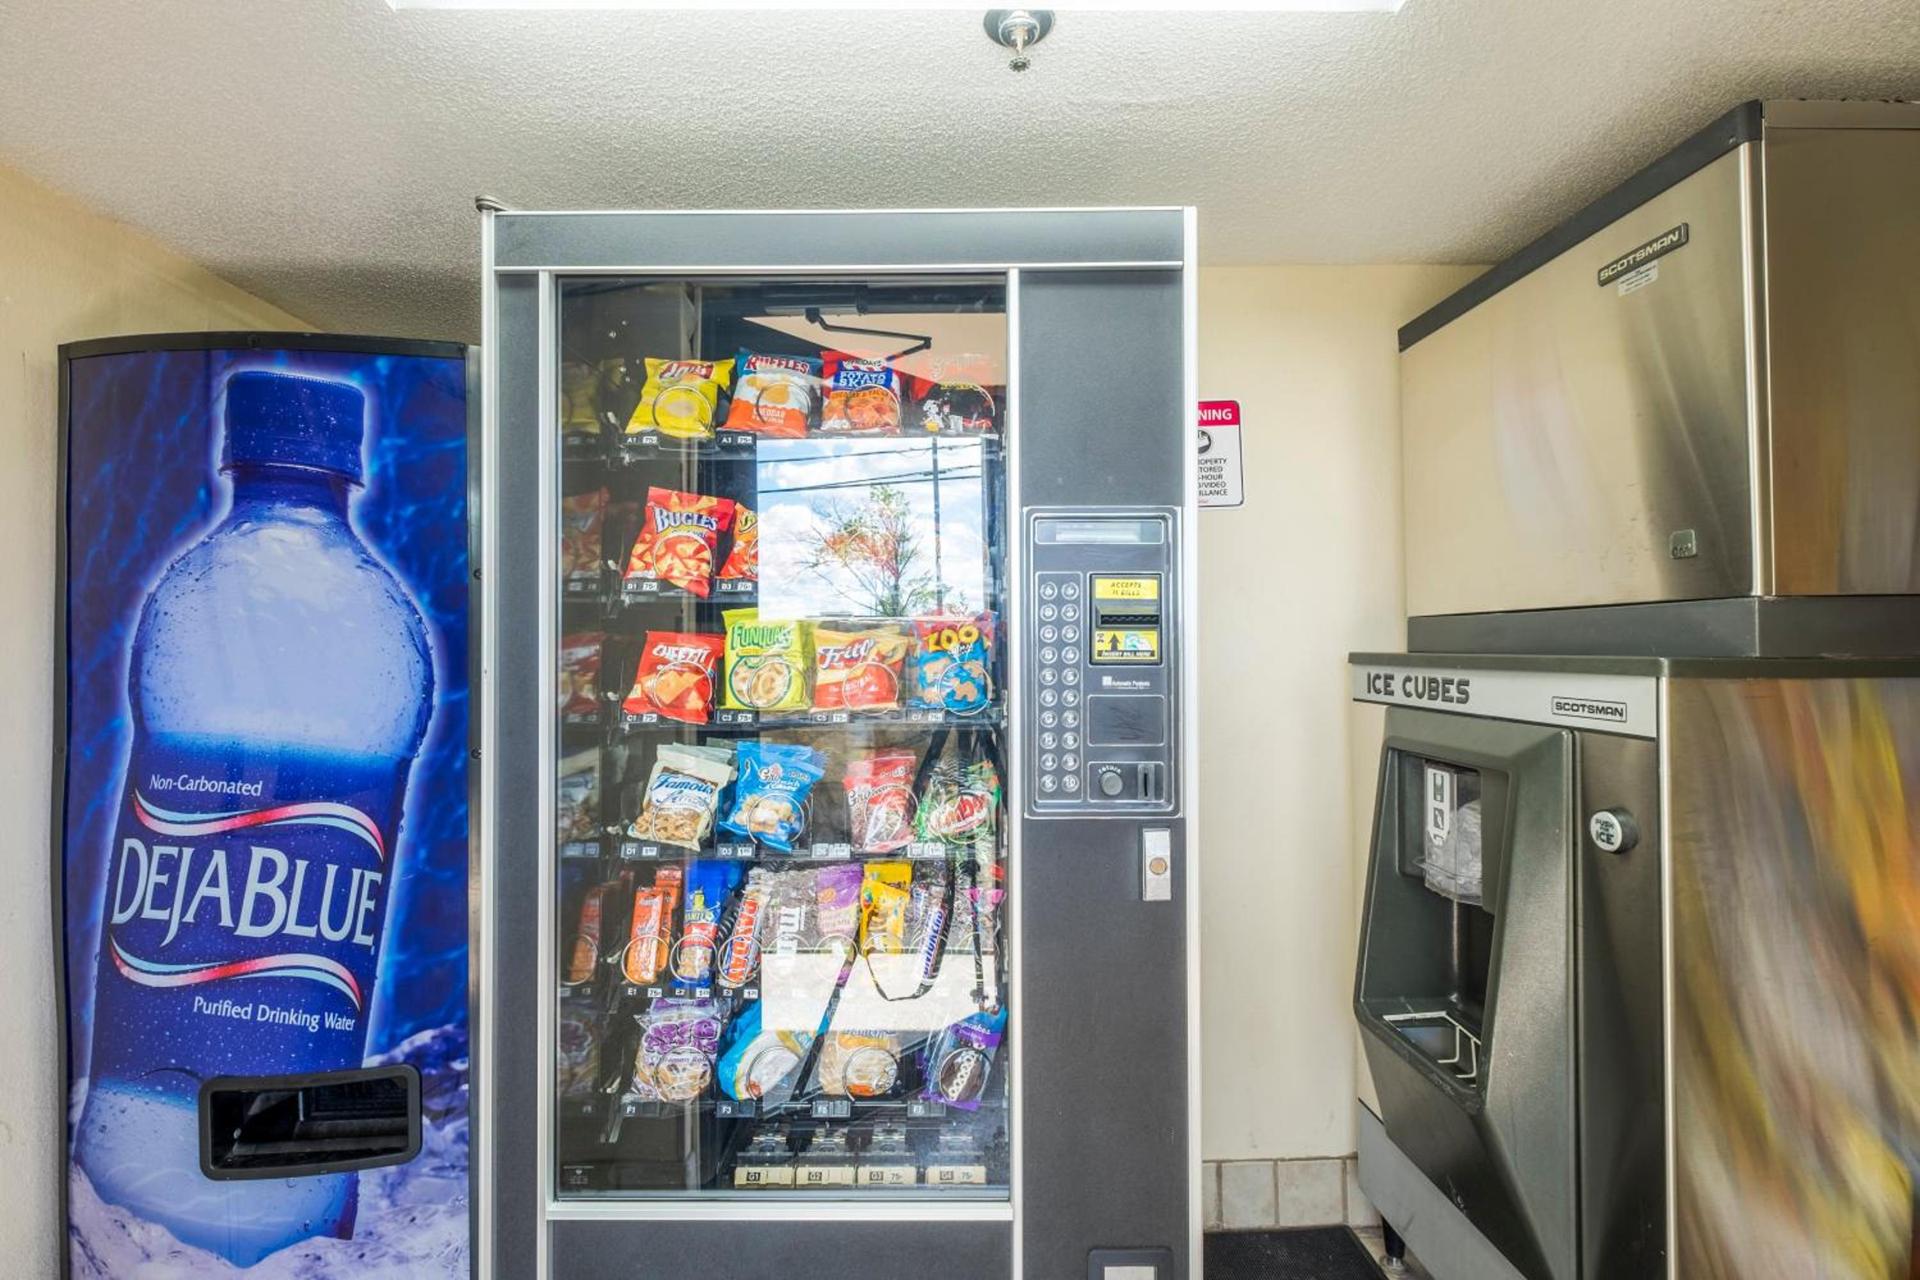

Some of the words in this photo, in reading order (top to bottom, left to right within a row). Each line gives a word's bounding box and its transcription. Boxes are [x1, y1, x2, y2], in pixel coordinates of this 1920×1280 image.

[1600, 230, 1680, 281] SCOTSMAN
[743, 353, 811, 375] RUFFLES
[839, 379, 886, 388] SKINS
[840, 371, 887, 382] POTATO
[627, 436, 637, 444] A1
[654, 507, 719, 533] BUGLES
[731, 622, 792, 650] FUNYUNS
[927, 623, 980, 652] ZOO
[1367, 671, 1395, 696] ICE
[1402, 674, 1471, 705] CUBES
[1555, 701, 1624, 718] SCOTSMAN
[149, 774, 263, 797] Non-Carbonated
[650, 771, 714, 794] Famous
[1596, 830, 1614, 845] ICE
[193, 996, 252, 1020] Purified
[256, 1004, 320, 1033] Drinking
[324, 1011, 356, 1032] Water
